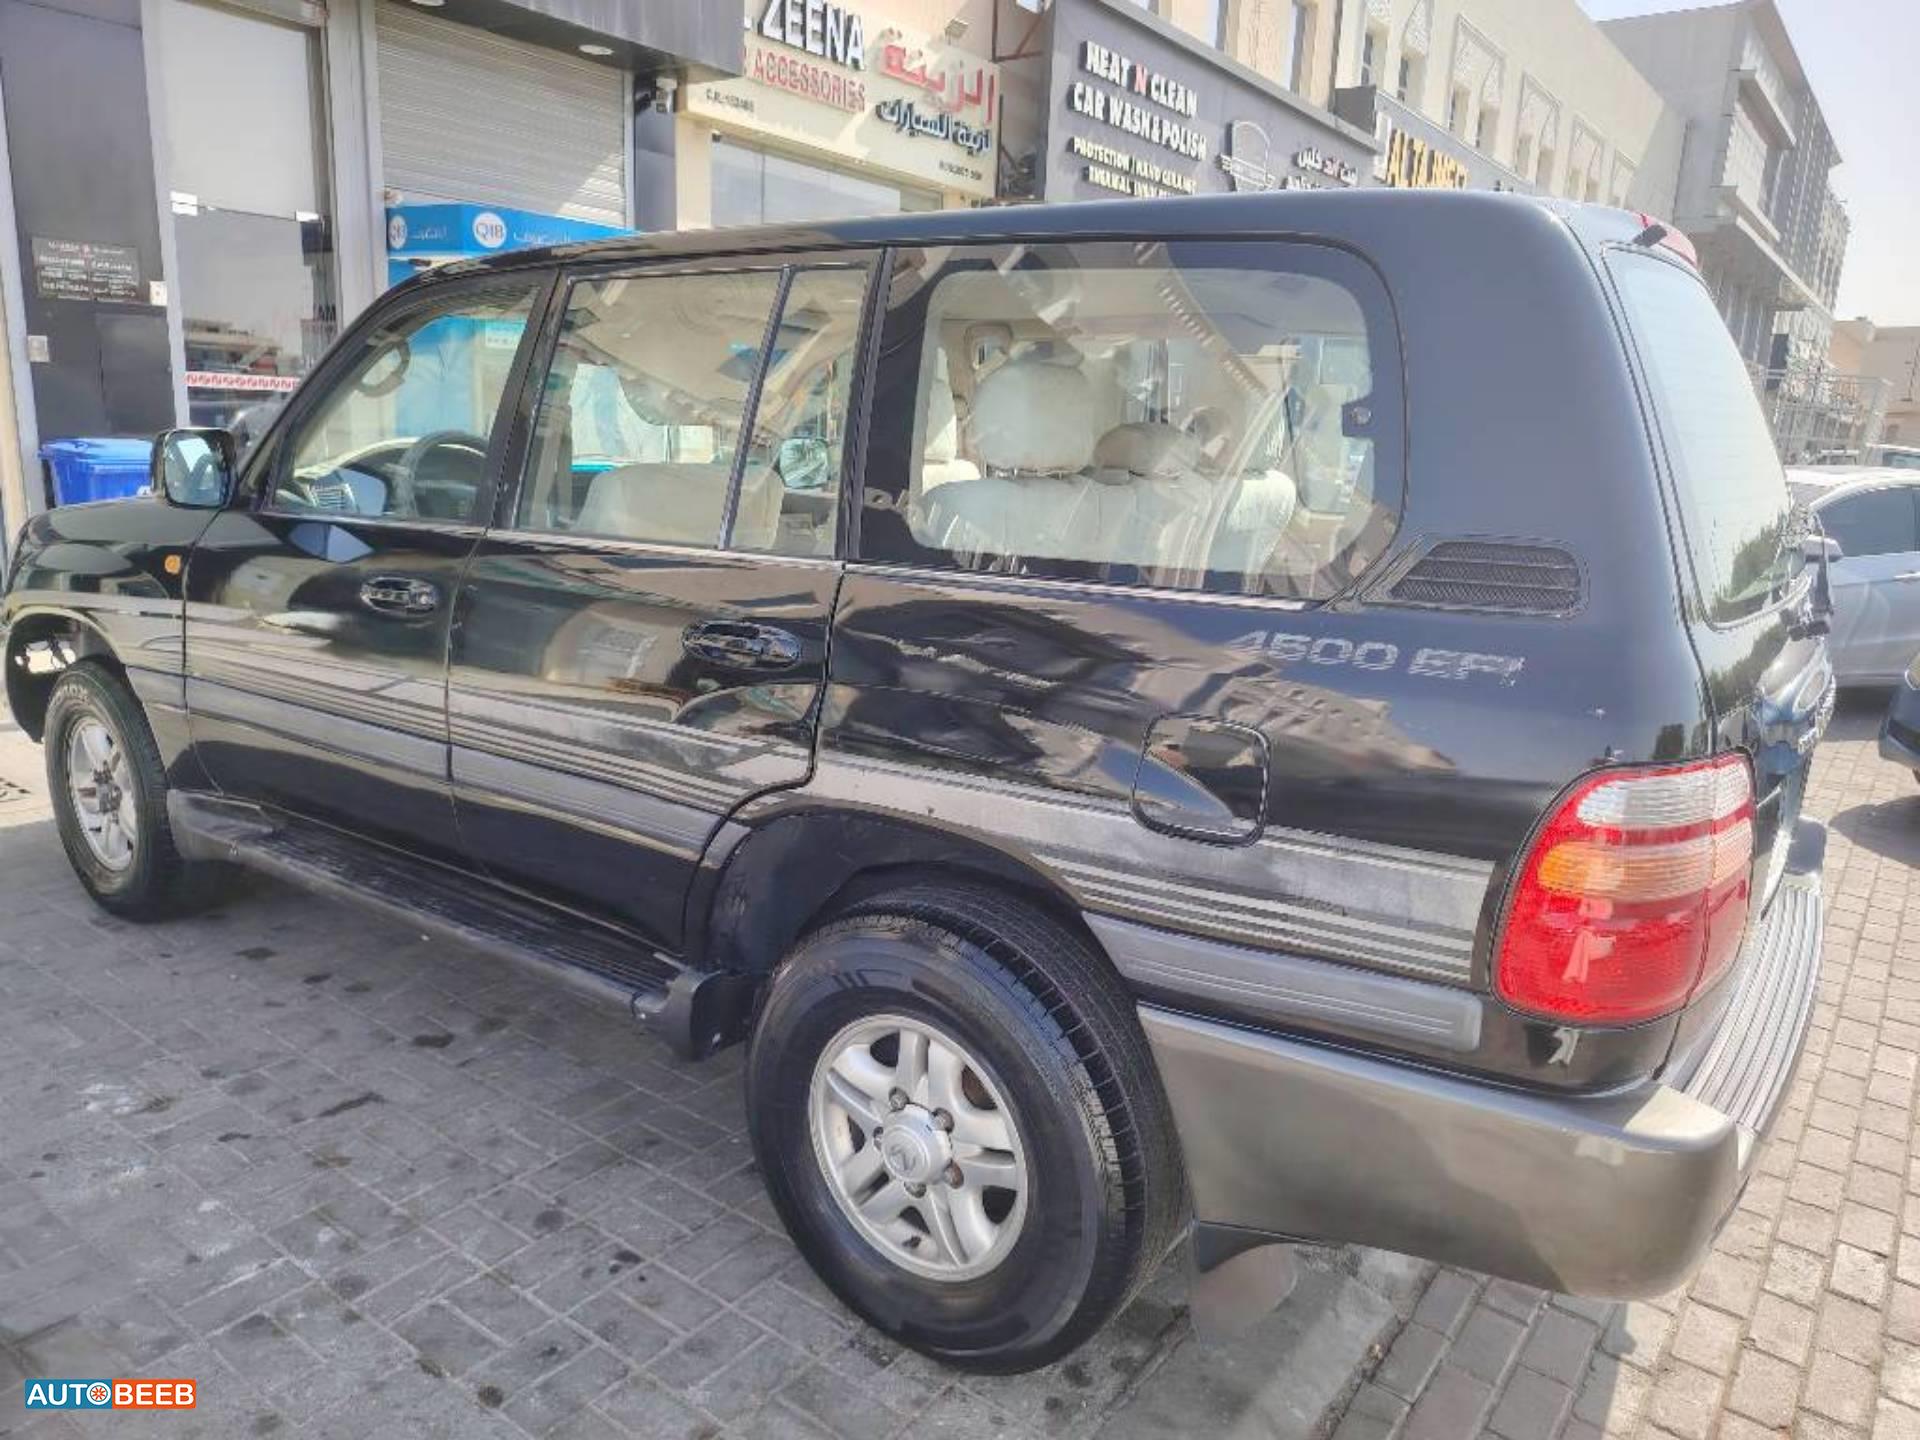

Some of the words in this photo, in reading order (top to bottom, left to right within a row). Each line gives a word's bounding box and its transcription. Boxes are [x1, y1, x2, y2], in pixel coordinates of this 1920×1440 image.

[762, 0, 865, 70] ZEENA
[753, 48, 865, 112] ACCESSORIES
[884, 28, 995, 124] الزينة
[1073, 81, 1105, 121] CAR
[1085, 40, 1131, 88] NEAT
[1134, 61, 1148, 96] N
[1150, 73, 1197, 119] CLEAN
[878, 98, 952, 138] السيارات
[1074, 136, 1130, 172] PROTECTION
